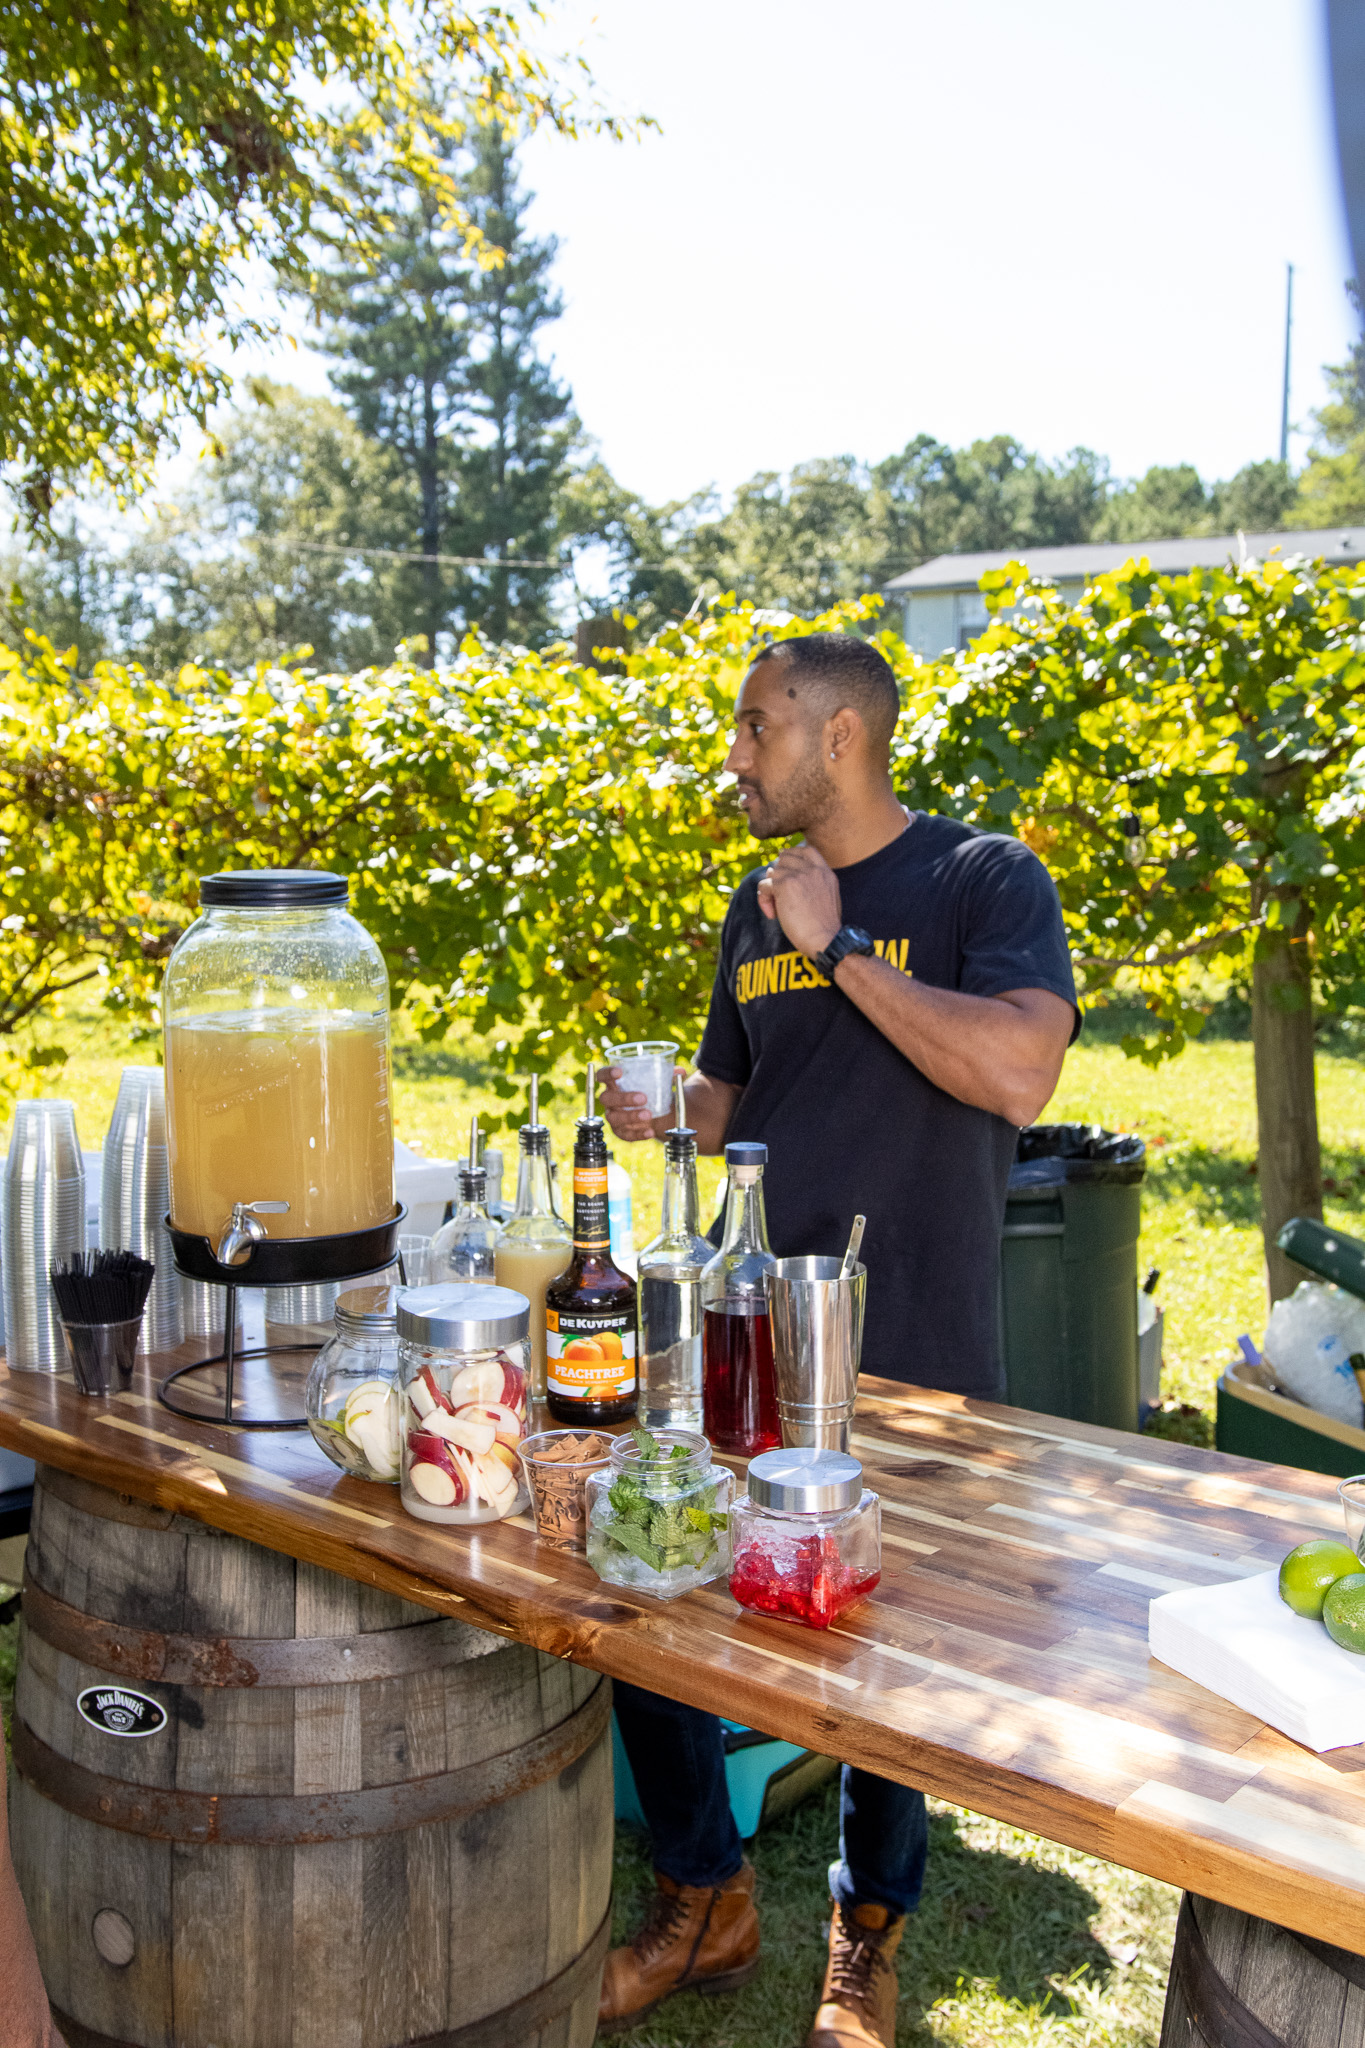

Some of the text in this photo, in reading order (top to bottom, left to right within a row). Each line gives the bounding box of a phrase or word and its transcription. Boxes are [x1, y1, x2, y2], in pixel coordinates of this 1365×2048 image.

[736, 938, 913, 1004] QUINTESAL
[559, 1317, 627, 1329] DE KUYPER
[555, 1365, 626, 1379] PEACHTREE
[96, 1693, 114, 1711] JACK
